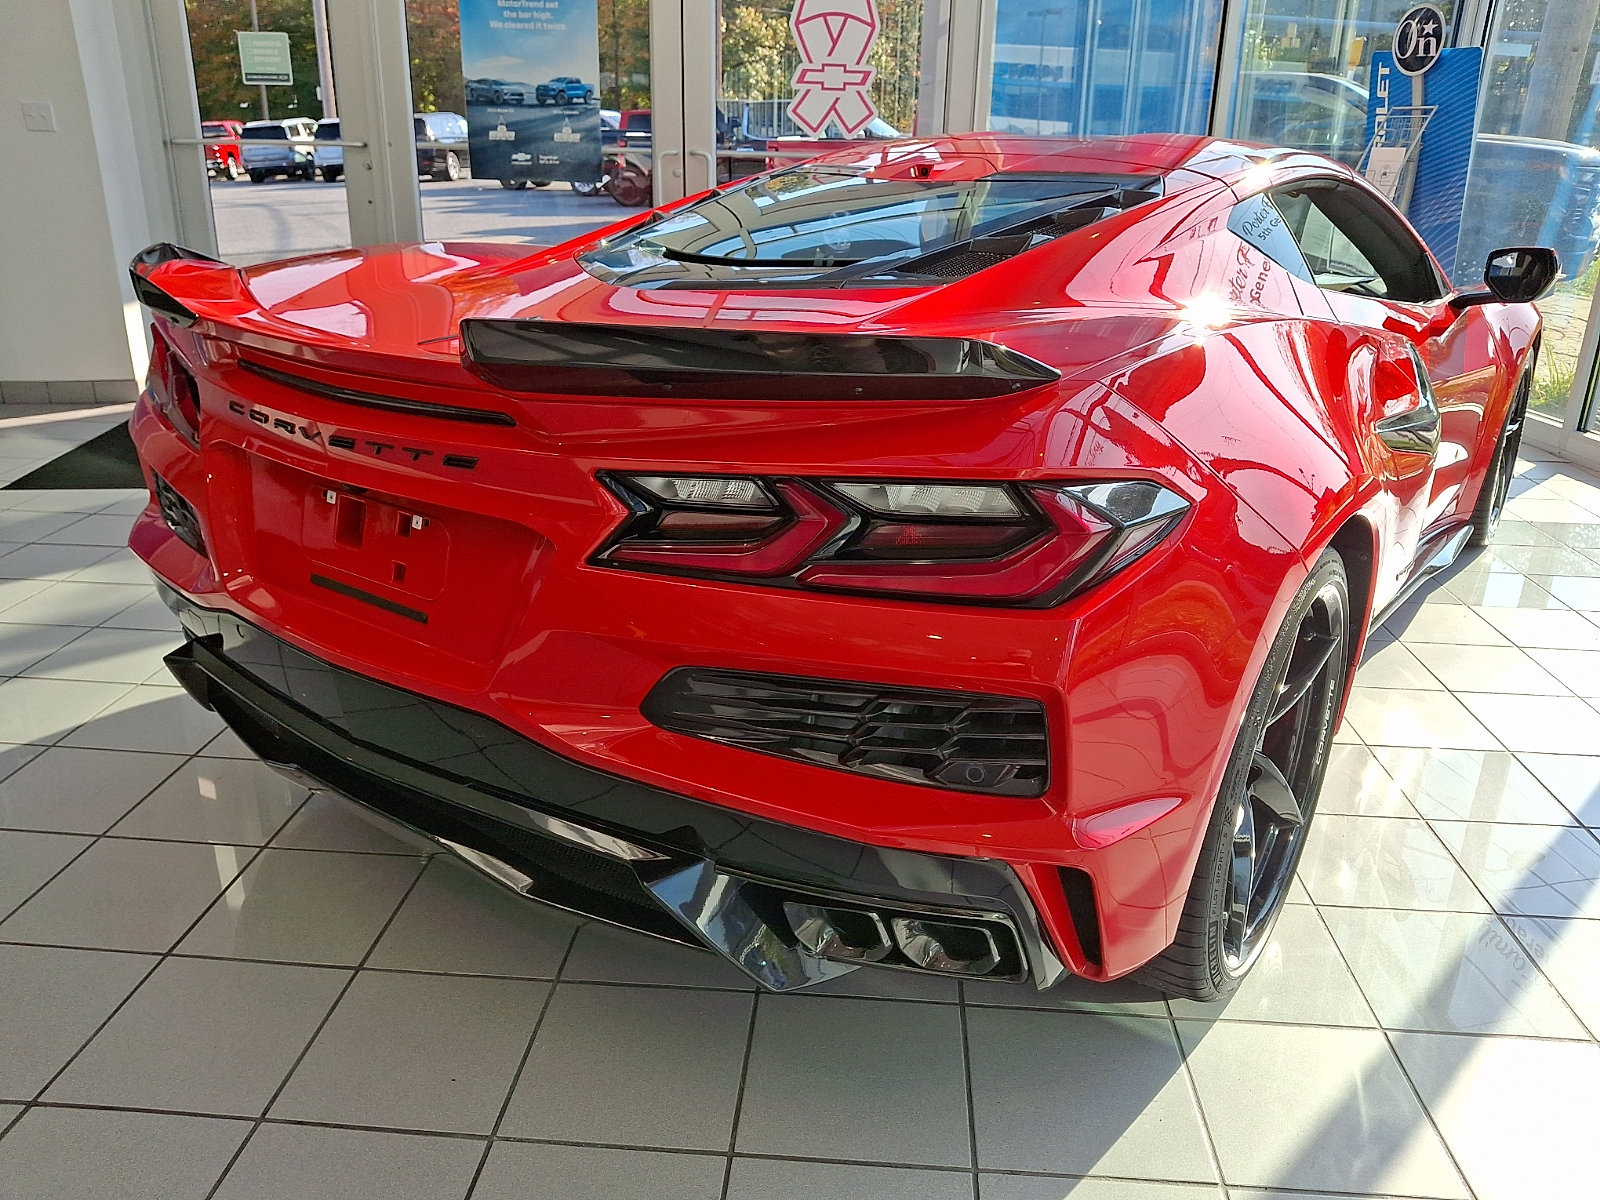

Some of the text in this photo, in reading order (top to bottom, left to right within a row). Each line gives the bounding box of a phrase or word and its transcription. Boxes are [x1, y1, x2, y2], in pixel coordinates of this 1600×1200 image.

[489, 20, 503, 28] We
[504, 21, 534, 29] cleared
[503, 10, 517, 18] the
[518, 11, 532, 19] bar
[1258, 228, 1273, 240] 5th
[229, 400, 480, 471] CORVETTE
[1316, 679, 1336, 766] CORVETTE
[1215, 851, 1226, 884] SPORT
